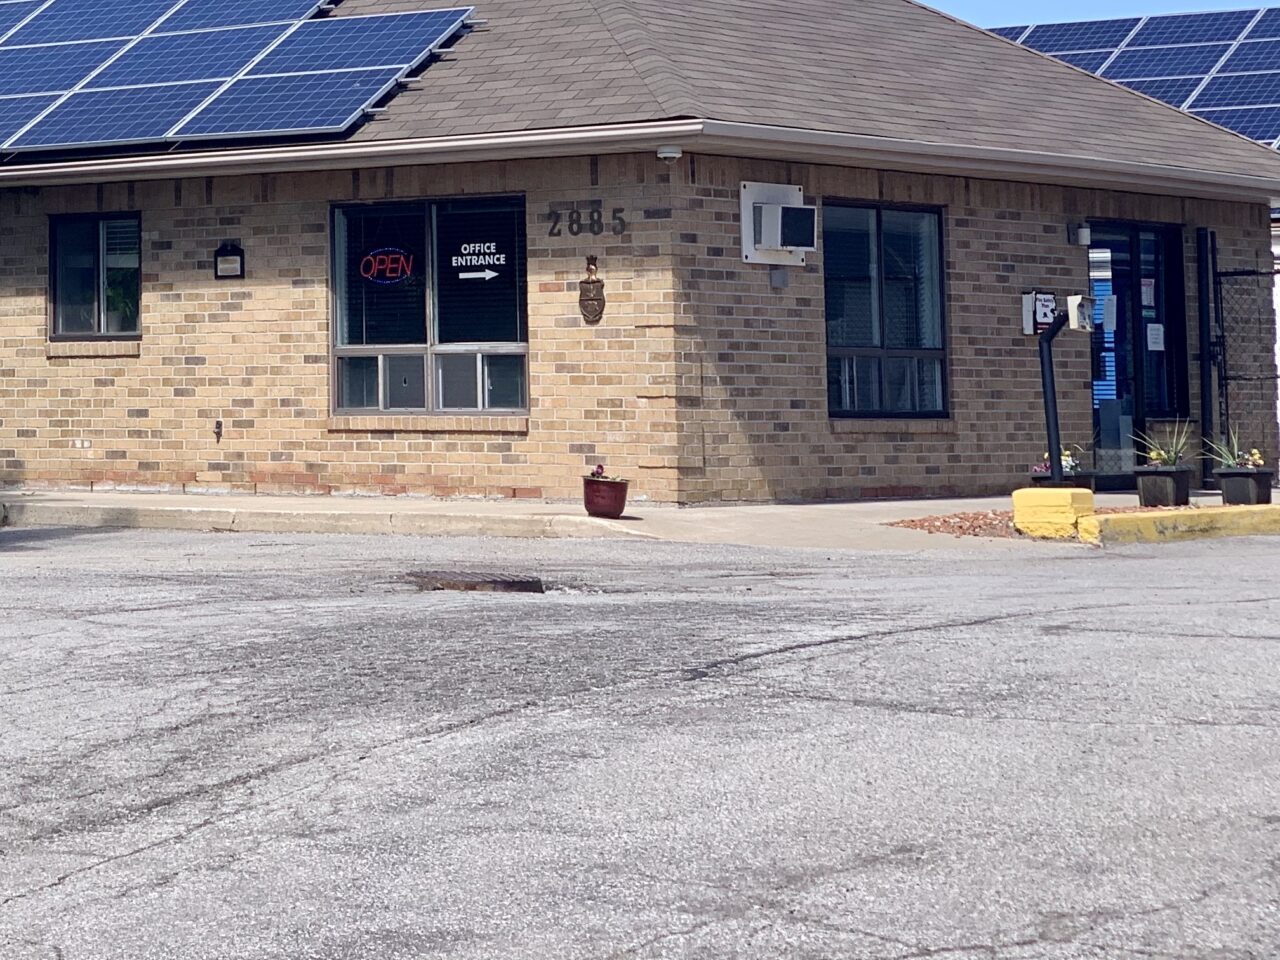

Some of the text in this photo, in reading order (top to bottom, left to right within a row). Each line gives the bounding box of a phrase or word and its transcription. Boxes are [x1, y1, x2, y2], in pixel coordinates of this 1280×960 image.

[548, 207, 626, 237] 2885
[460, 242, 497, 254] OFFICE
[359, 254, 414, 278] OPEN
[451, 254, 506, 267] ENTRANCE
